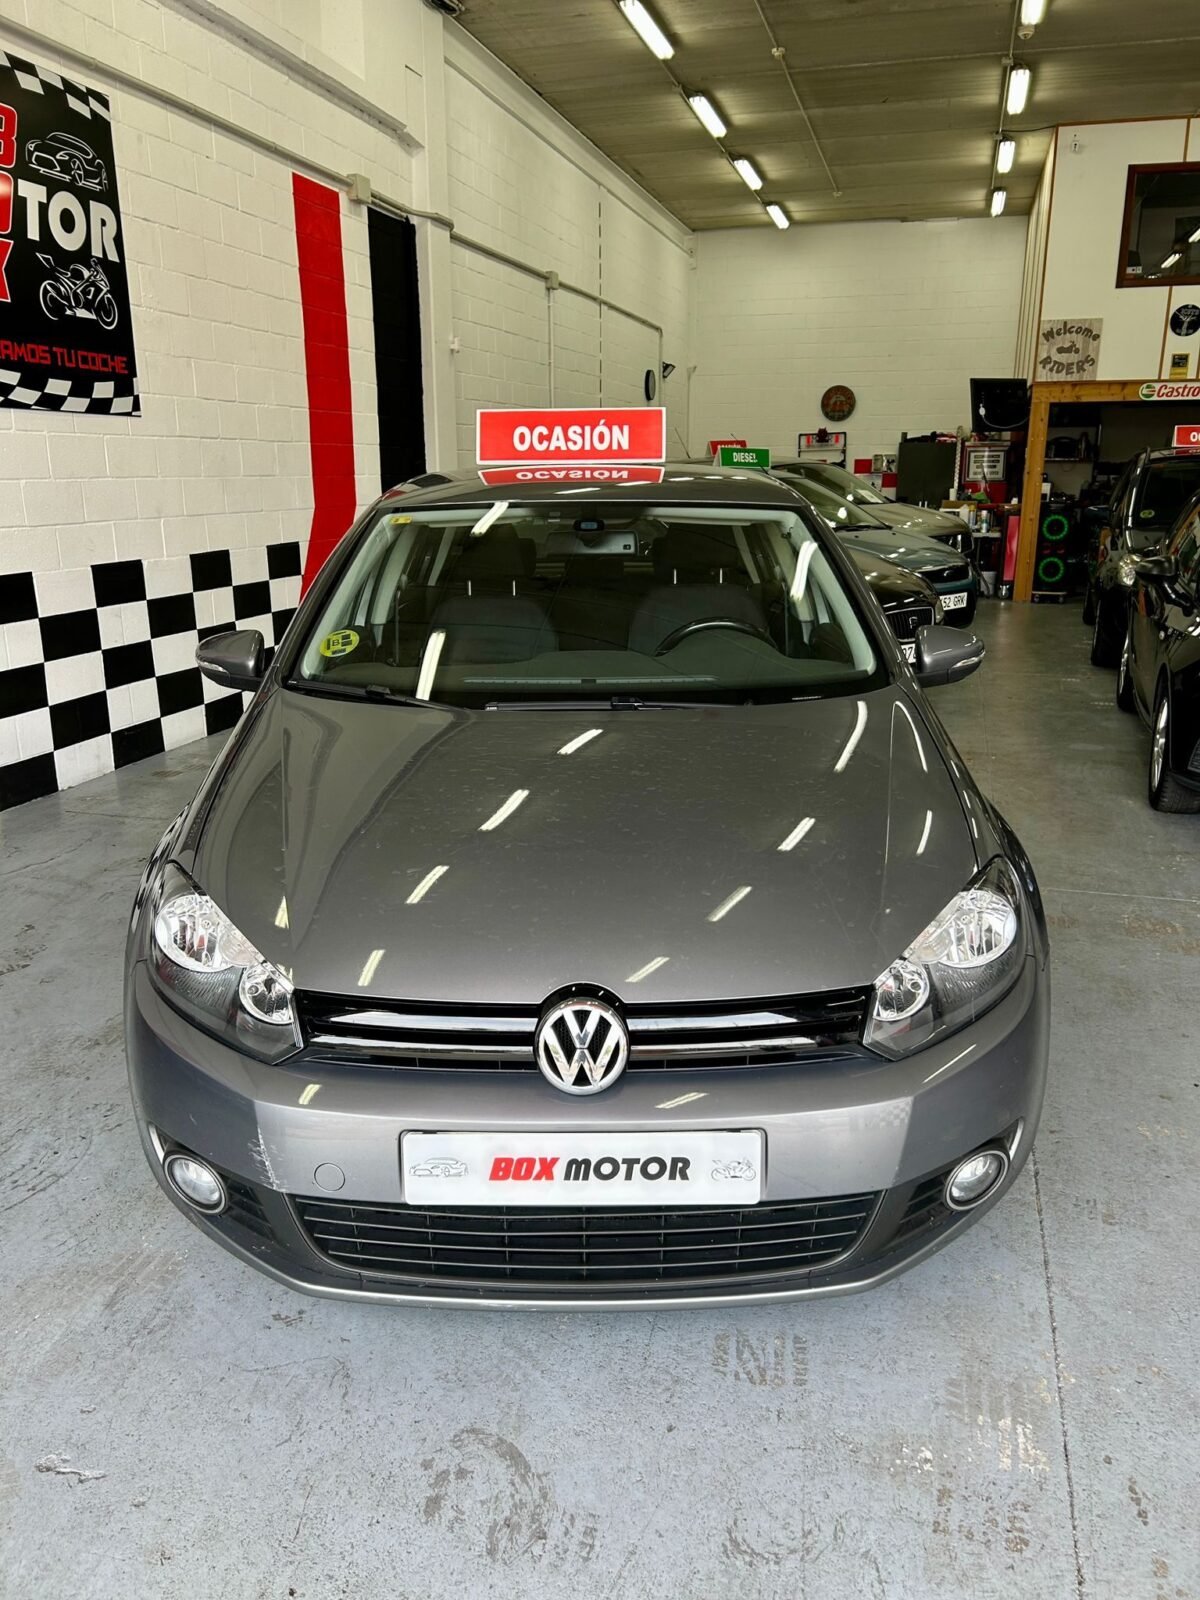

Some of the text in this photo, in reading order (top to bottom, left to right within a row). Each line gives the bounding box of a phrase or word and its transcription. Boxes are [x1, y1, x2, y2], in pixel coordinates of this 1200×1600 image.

[1042, 321, 1101, 343] Welcome
[0, 340, 128, 374] AMOS TU COCHE
[1039, 354, 1096, 376] RIDERS
[512, 419, 630, 451] OCASIÓN
[1189, 431, 1200, 442] O
[732, 452, 758, 463] DIESEL
[488, 1156, 691, 1181] BOX MOTOR
